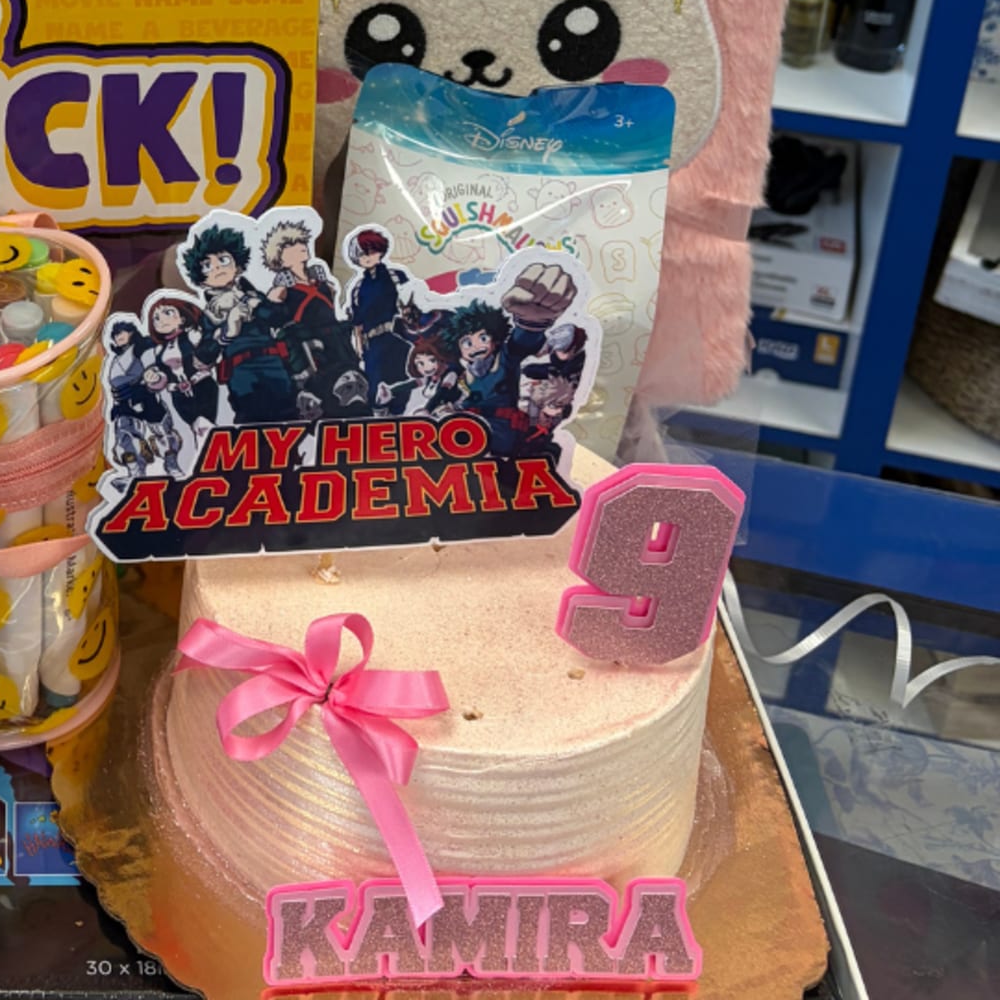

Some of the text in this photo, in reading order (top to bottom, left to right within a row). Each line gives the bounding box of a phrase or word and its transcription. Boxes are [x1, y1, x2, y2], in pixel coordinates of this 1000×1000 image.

[46, 21, 123, 41] NAME
[182, 17, 315, 39] BEVERAGE
[613, 114, 635, 128] 3+
[444, 182, 494, 201] RIGINAL
[202, 418, 488, 472] MY HERO
[102, 459, 576, 533] ACADEMIA
[556, 463, 746, 666] 9
[263, 877, 702, 986] KAMIRA
[85, 960, 113, 976] 30
